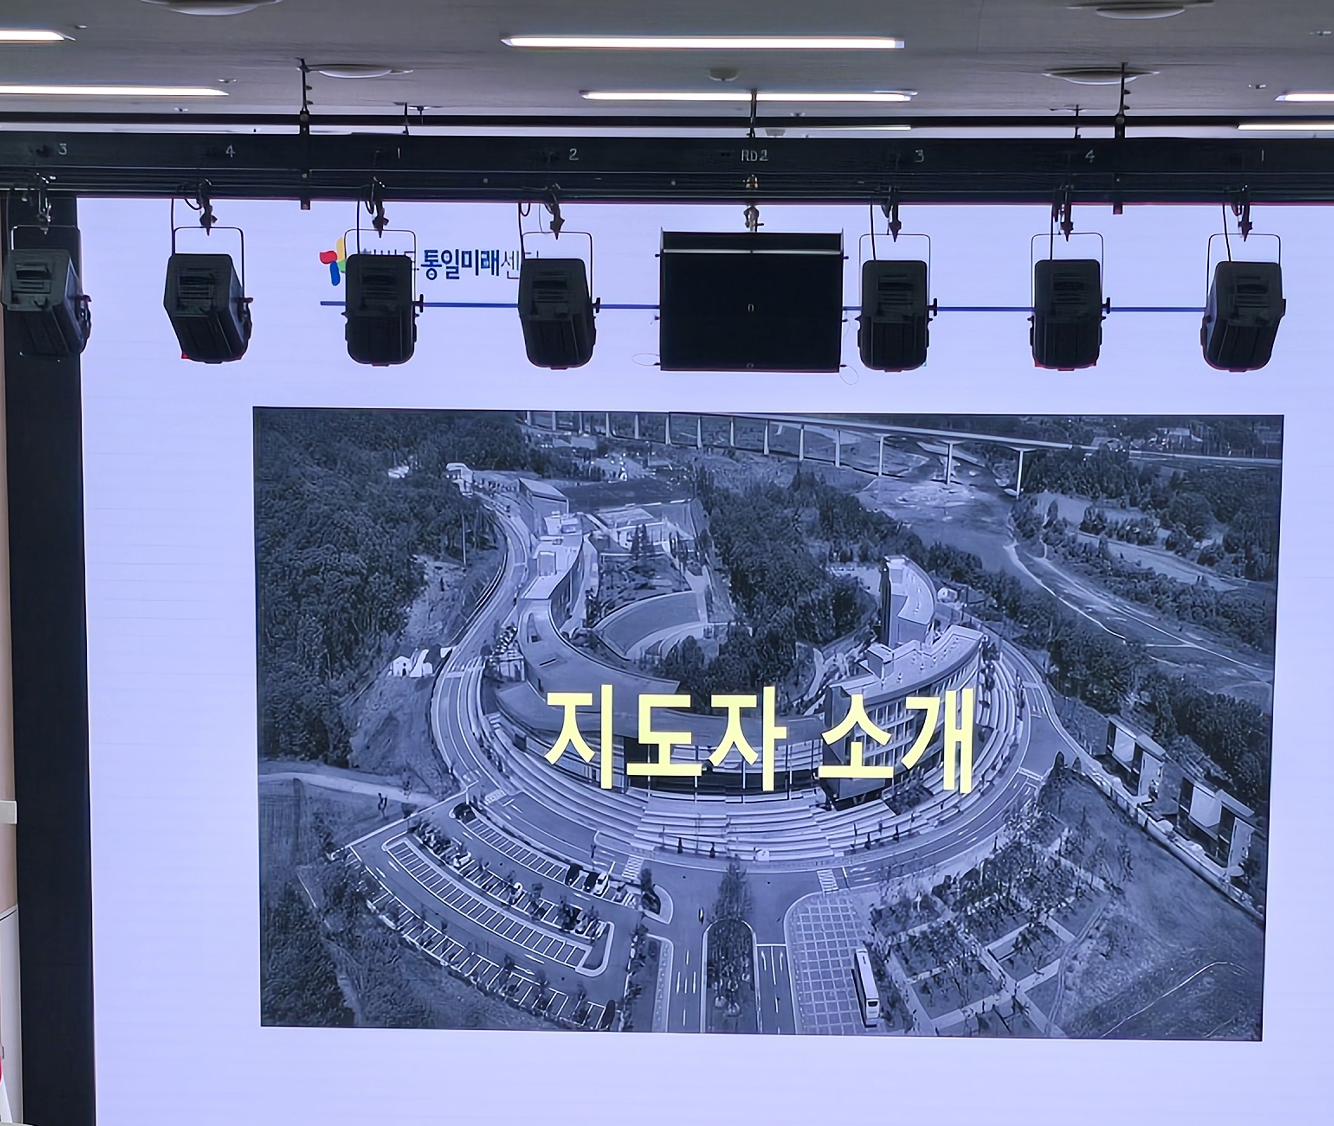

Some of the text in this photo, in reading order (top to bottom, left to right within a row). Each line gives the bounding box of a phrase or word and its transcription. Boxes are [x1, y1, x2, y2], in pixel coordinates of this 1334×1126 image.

[58, 143, 68, 155] 3
[225, 144, 236, 158] 4
[568, 148, 579, 161] 2
[915, 149, 925, 163] 3
[1085, 149, 1095, 163] 4
[362, 248, 539, 281] 통일미래센
[544, 684, 974, 794] 지도자 소개
